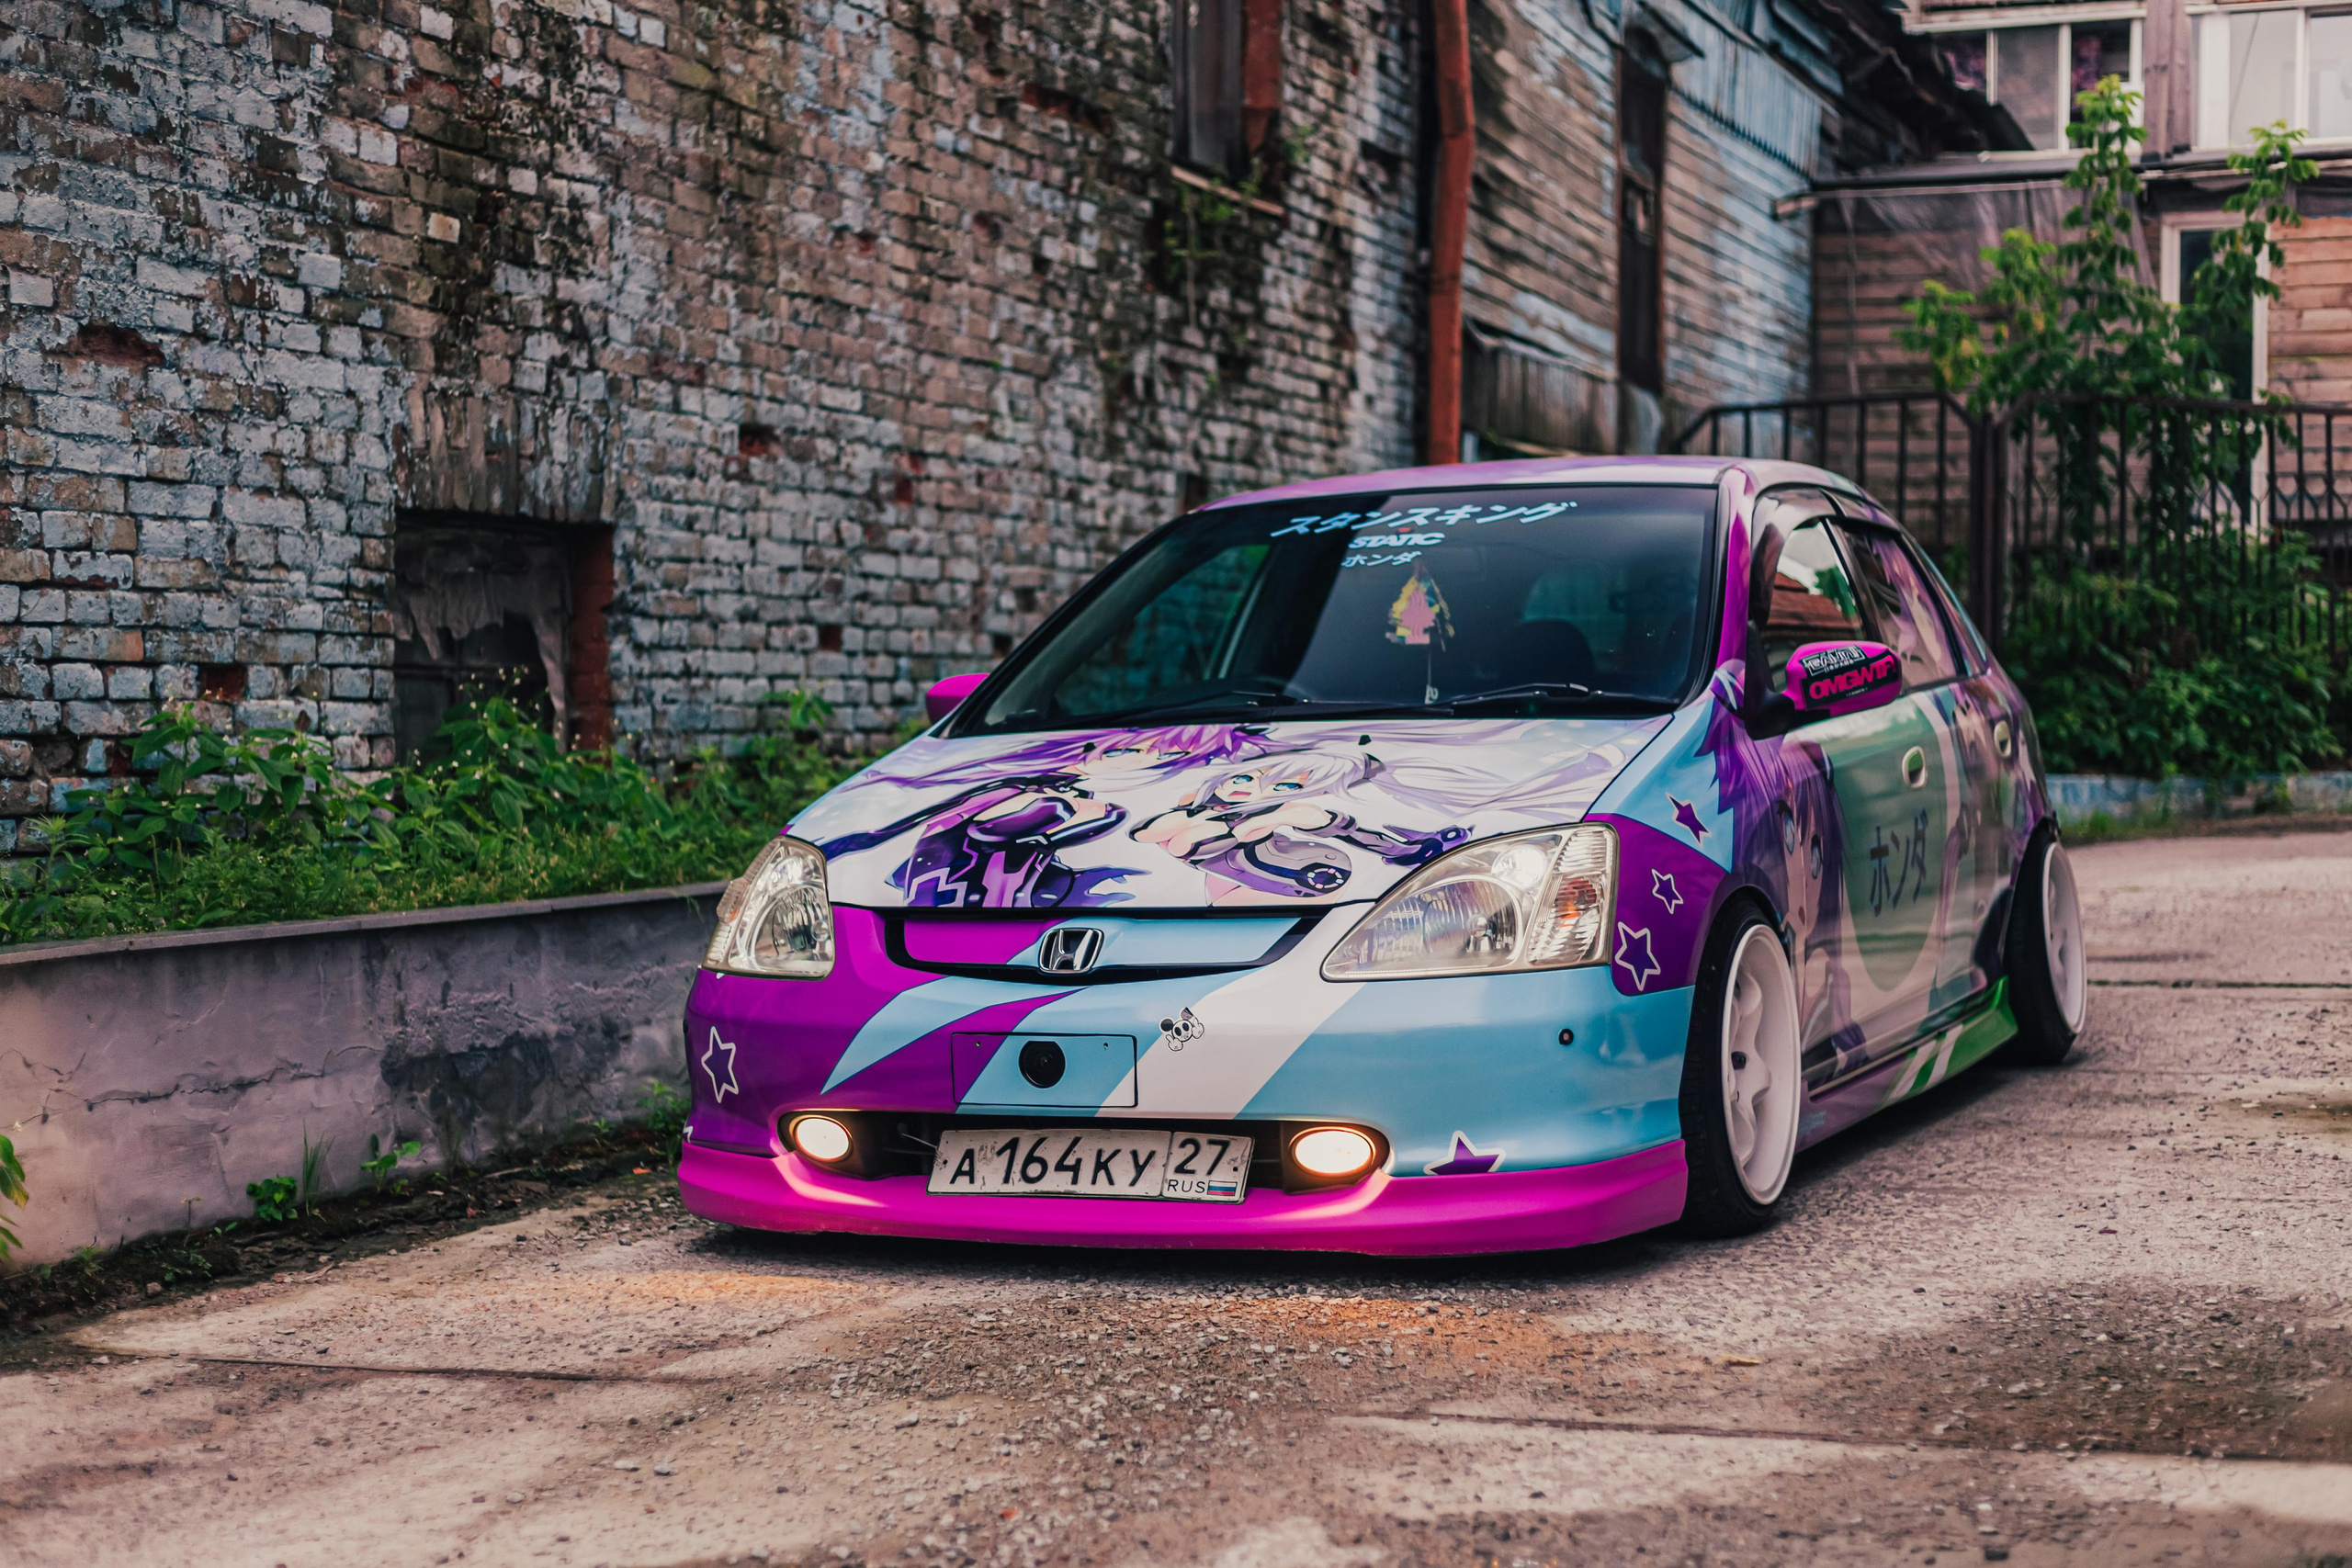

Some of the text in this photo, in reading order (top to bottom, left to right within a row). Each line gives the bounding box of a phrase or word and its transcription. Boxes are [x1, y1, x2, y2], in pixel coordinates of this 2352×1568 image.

[1270, 501, 1577, 537] スタンスキング
[1347, 531, 1446, 549] STATIC
[1340, 550, 1422, 569] ホンダ
[1869, 807, 1929, 917] ホンダ
[1174, 1138, 1231, 1177] 27
[1167, 1179, 1206, 1194] RUS
